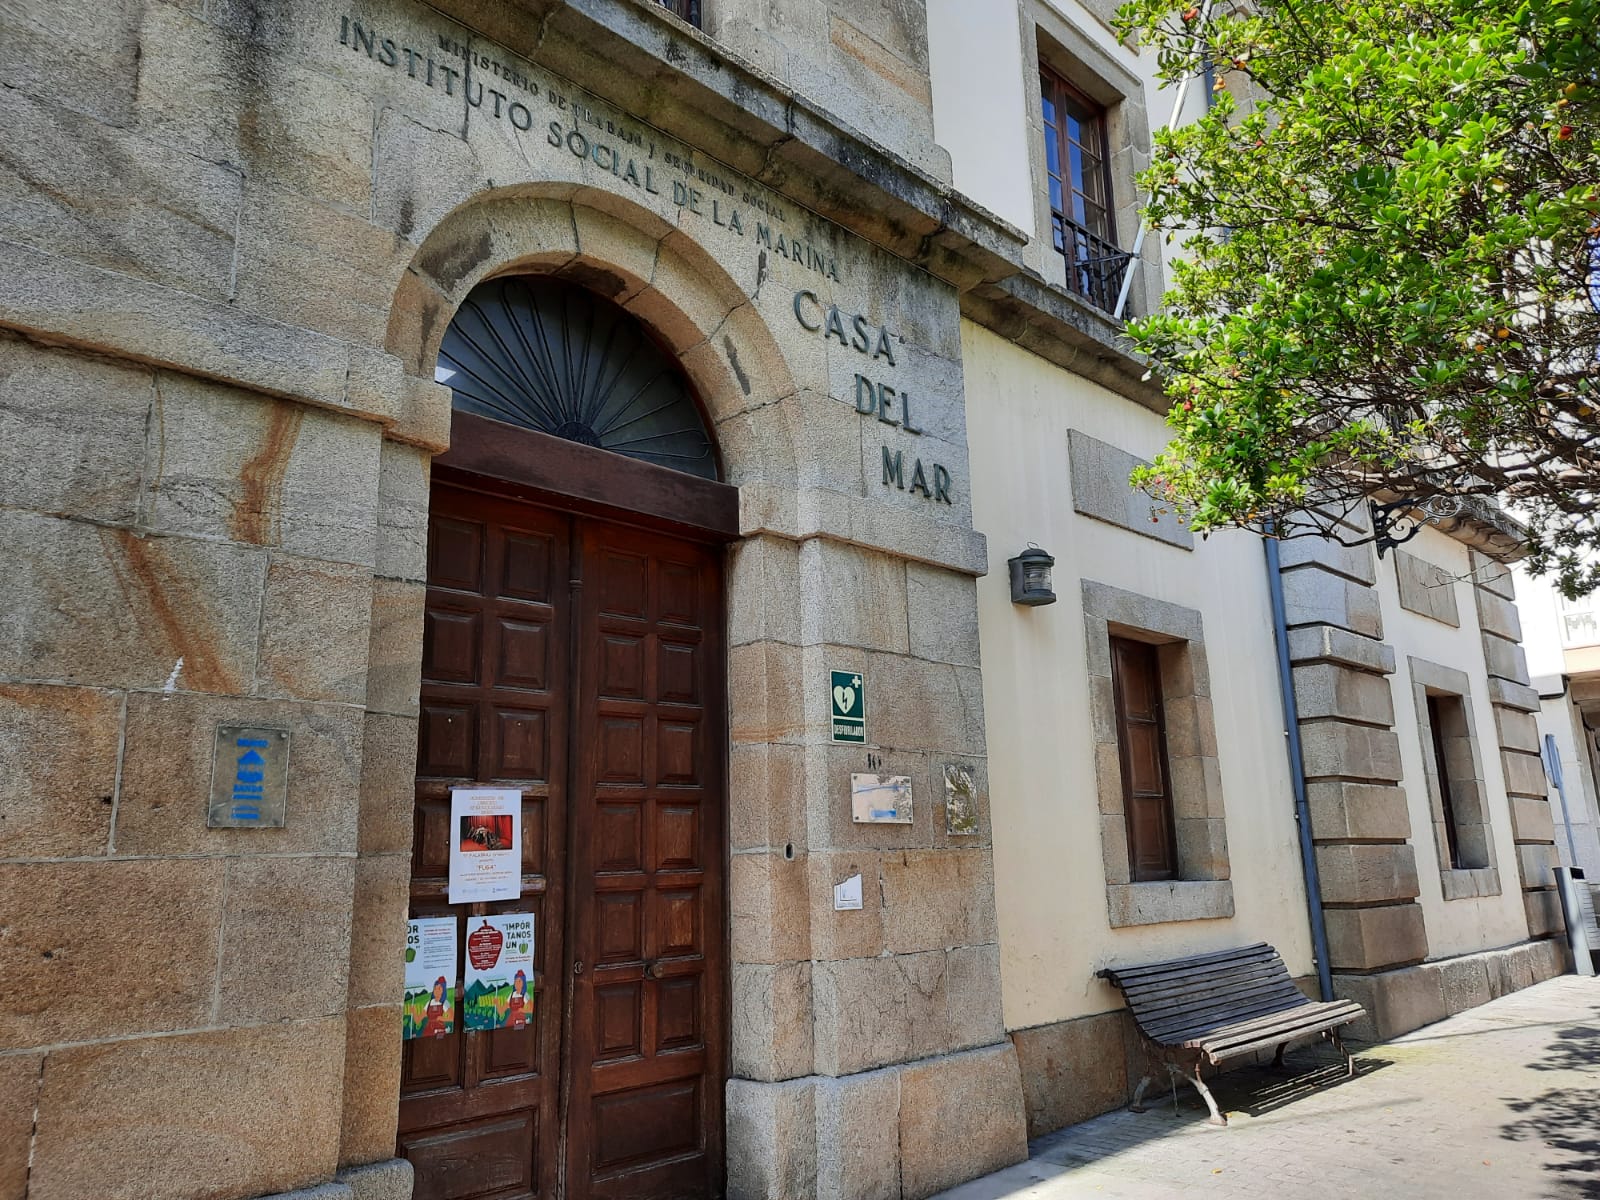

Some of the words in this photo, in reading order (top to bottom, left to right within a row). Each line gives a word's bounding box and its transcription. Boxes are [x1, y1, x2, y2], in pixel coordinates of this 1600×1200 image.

[438, 34, 539, 97] MINISTERIO
[548, 89, 567, 110] DE
[338, 15, 533, 131] INSTITUTO
[547, 121, 659, 195] SOCIAL
[673, 180, 703, 216] DE
[712, 199, 744, 236] LA
[756, 221, 841, 283] MARINA
[793, 288, 896, 367] CASA
[854, 373, 922, 435] DEL
[881, 445, 952, 504] MAR
[505, 941, 517, 949] UN
